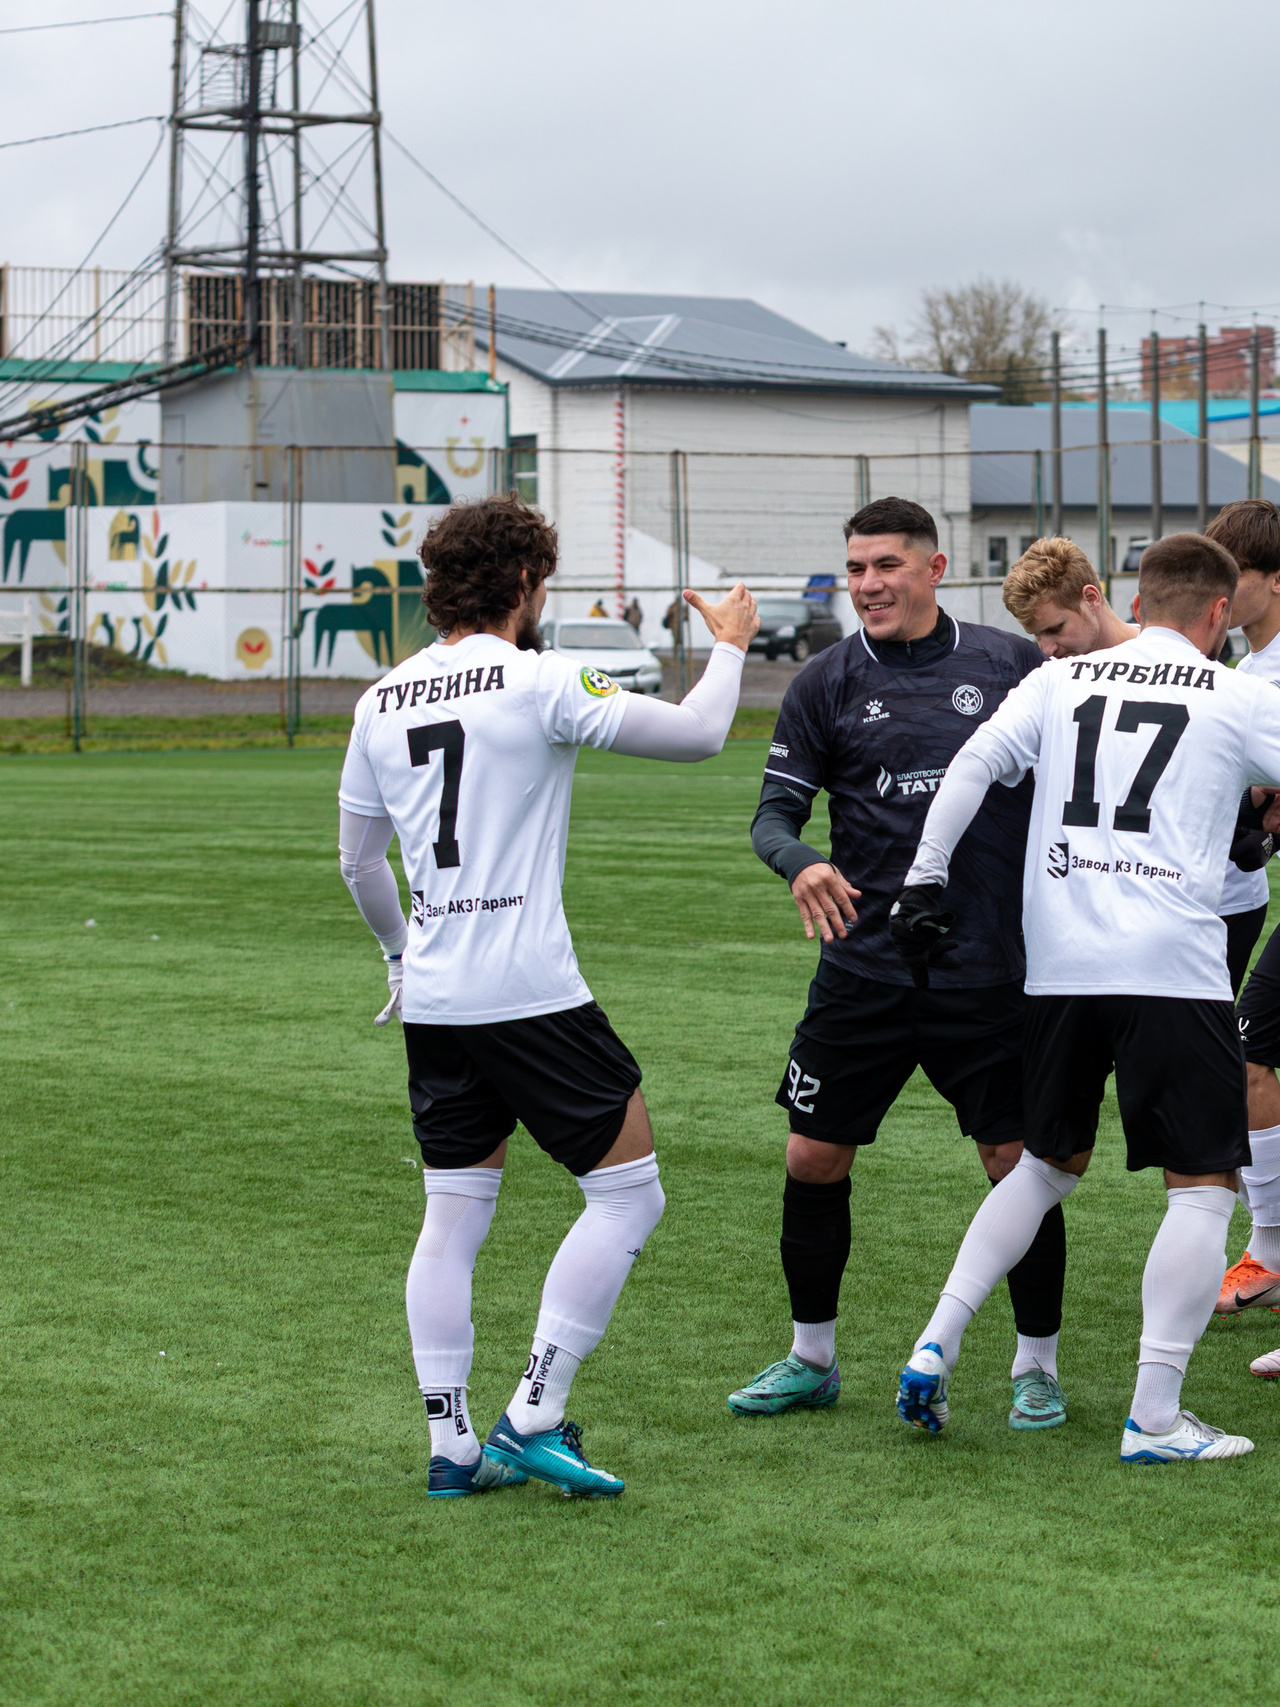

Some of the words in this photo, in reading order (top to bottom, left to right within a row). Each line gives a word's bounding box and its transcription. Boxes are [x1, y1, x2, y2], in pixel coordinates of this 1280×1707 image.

[376, 664, 505, 714] ТУРБИНА
[1071, 661, 1216, 691] ТУРБИНА
[863, 711, 891, 724] KELME
[896, 767, 948, 782] БЛАГОТВОРИТ
[1061, 694, 1191, 834] 17
[406, 718, 466, 870] 7
[1071, 855, 1110, 874] Завод
[1113, 860, 1132, 873] КЗ
[1135, 862, 1182, 881] Гарант
[447, 898, 474, 915] АКЗ
[474, 895, 525, 913] Гарант
[787, 1058, 822, 1114] 92
